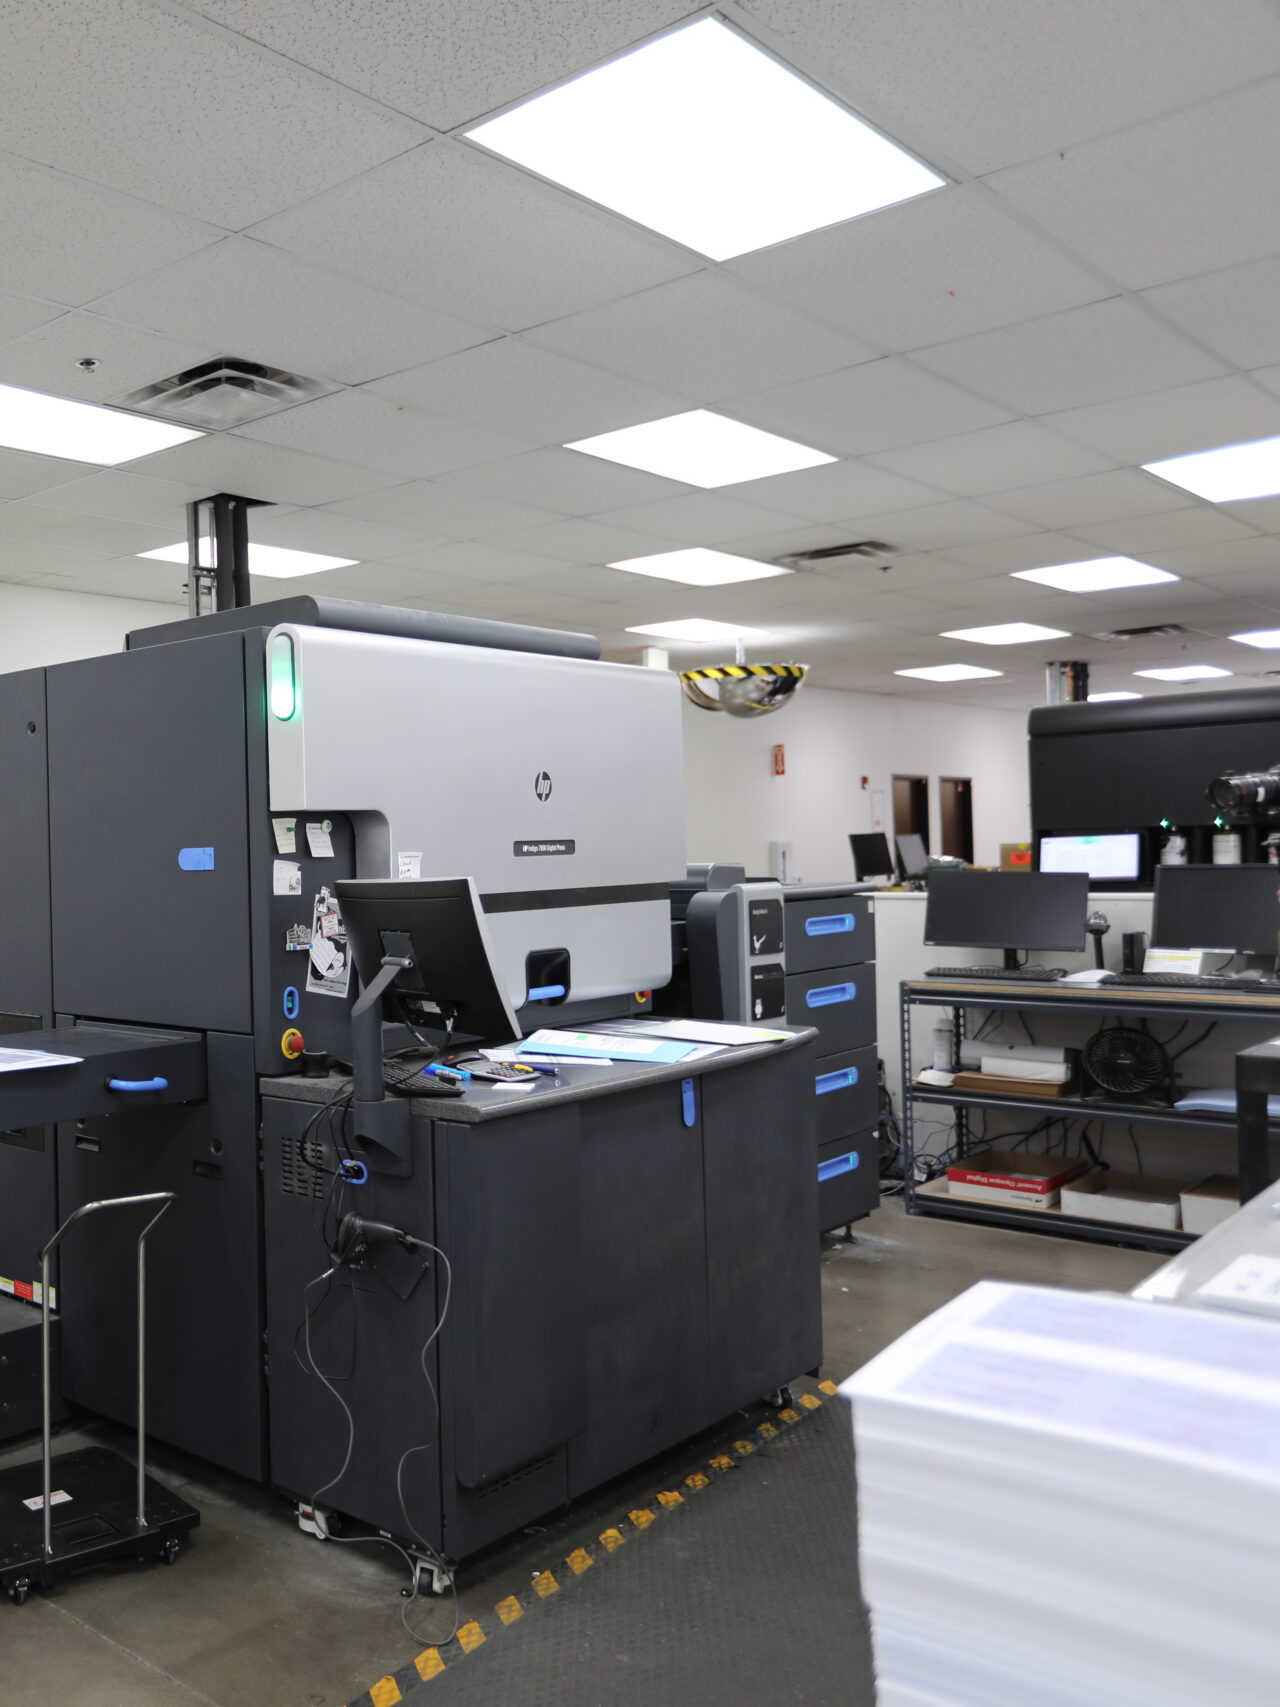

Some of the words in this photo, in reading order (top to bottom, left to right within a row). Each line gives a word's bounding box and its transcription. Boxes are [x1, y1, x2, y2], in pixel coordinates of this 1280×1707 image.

[536, 771, 551, 802] hp
[966, 1174, 988, 1183] Digital
[989, 1177, 1016, 1187] Opaque
